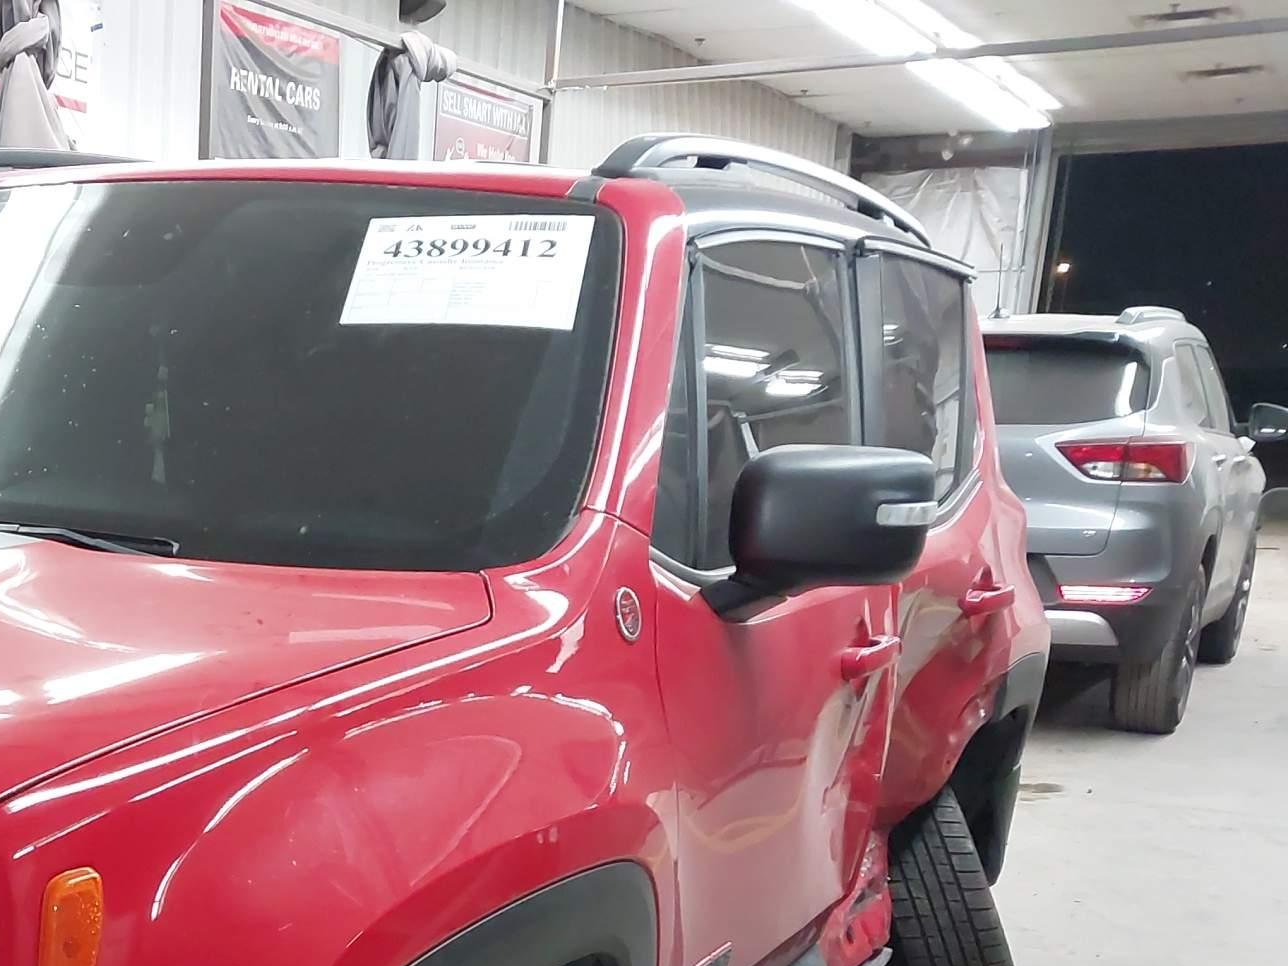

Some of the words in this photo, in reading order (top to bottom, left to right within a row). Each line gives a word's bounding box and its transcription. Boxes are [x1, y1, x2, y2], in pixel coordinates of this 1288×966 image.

[230, 66, 282, 102] RENTAL
[286, 81, 321, 111] CARS
[442, 90, 462, 115] SELL
[463, 95, 492, 124] SMART
[492, 105, 512, 132] WITH
[383, 238, 558, 258] 43899412
